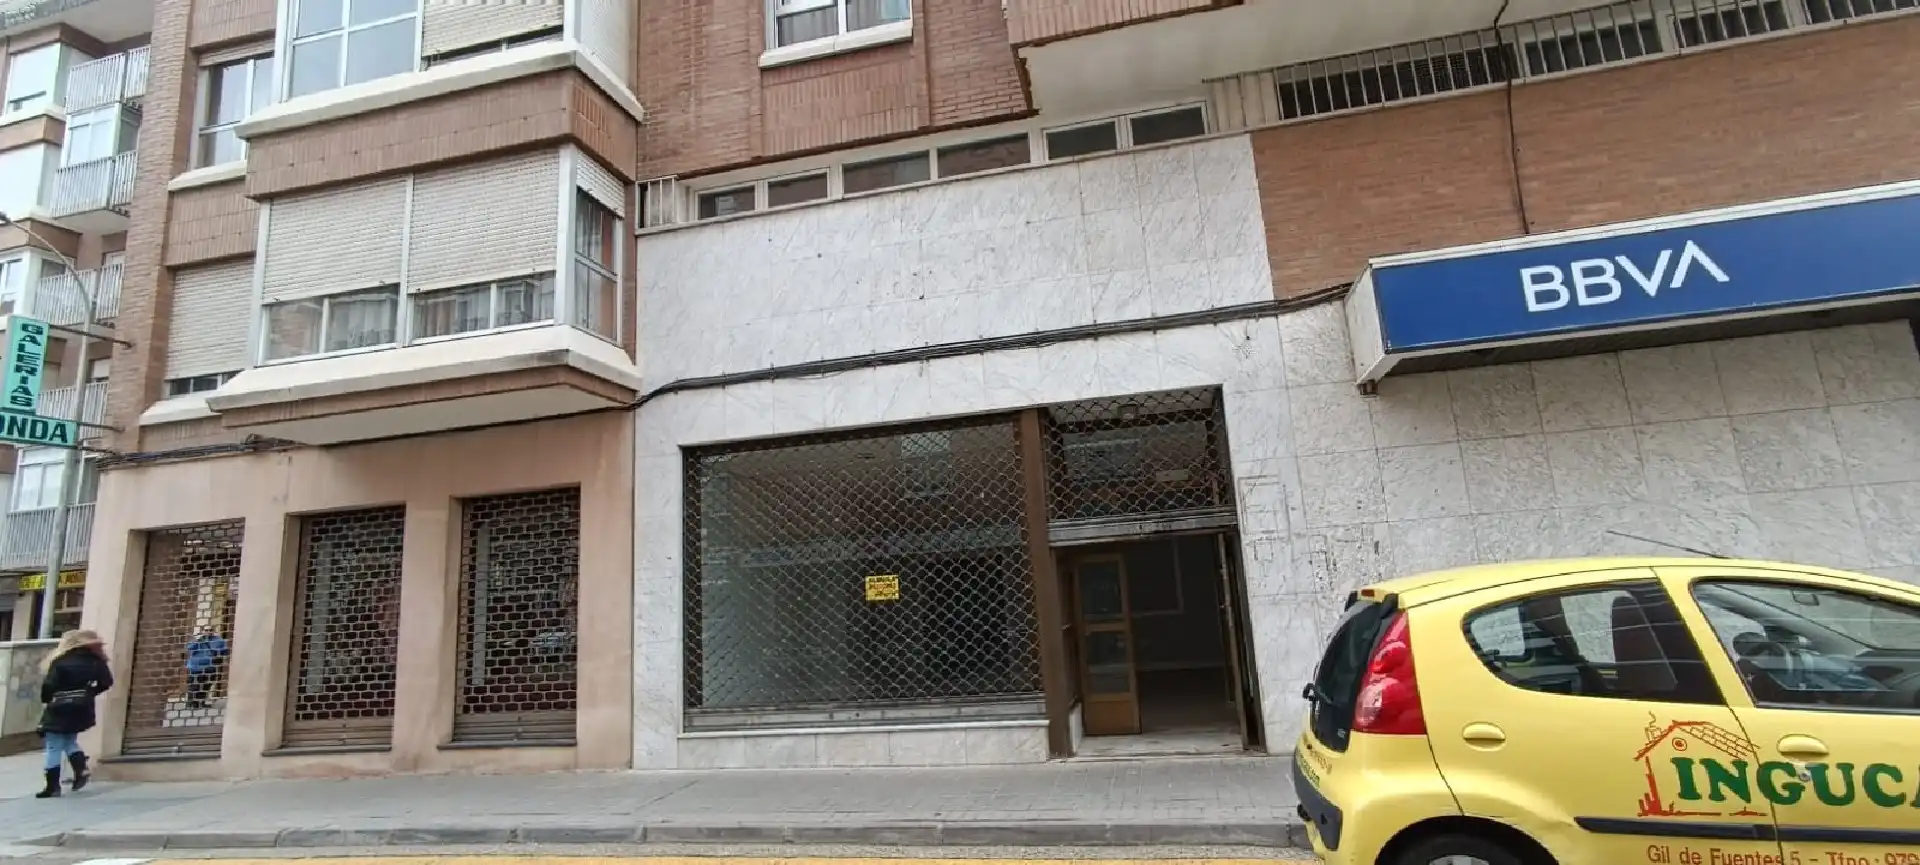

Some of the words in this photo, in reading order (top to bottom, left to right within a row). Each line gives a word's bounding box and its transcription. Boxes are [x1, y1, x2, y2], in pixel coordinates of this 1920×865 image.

[1519, 239, 1730, 312] BBVA
[10, 323, 44, 407] GALERIAS
[1670, 756, 1920, 808] INGUC
[1647, 844, 1670, 864] Gil
[1679, 846, 1702, 865] de
[1709, 847, 1783, 865] Fuentes
[1790, 850, 1801, 865] 5
